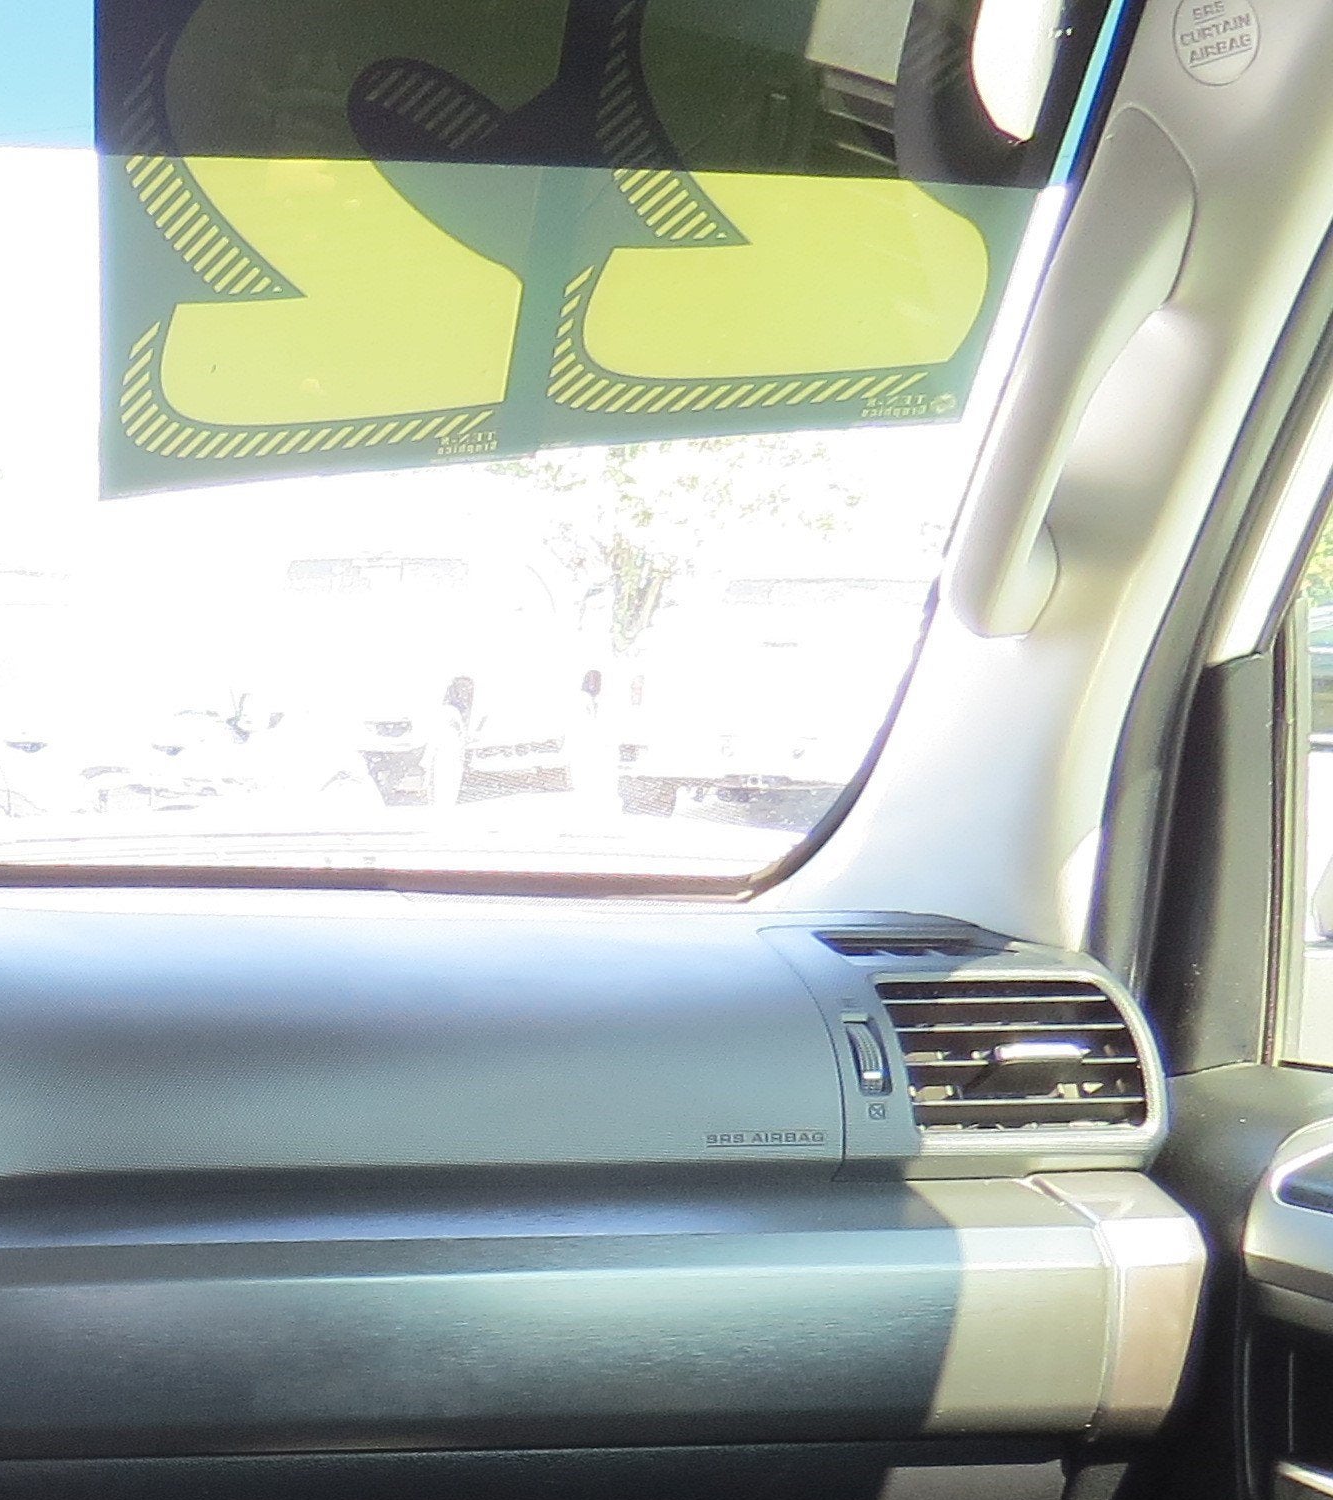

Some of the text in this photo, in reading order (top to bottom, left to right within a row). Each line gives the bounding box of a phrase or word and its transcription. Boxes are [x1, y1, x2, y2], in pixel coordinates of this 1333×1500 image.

[1180, 13, 1250, 47] CURTAIN
[1189, 33, 1251, 63] AIRBAG
[751, 1132, 824, 1143] AIRBAG
